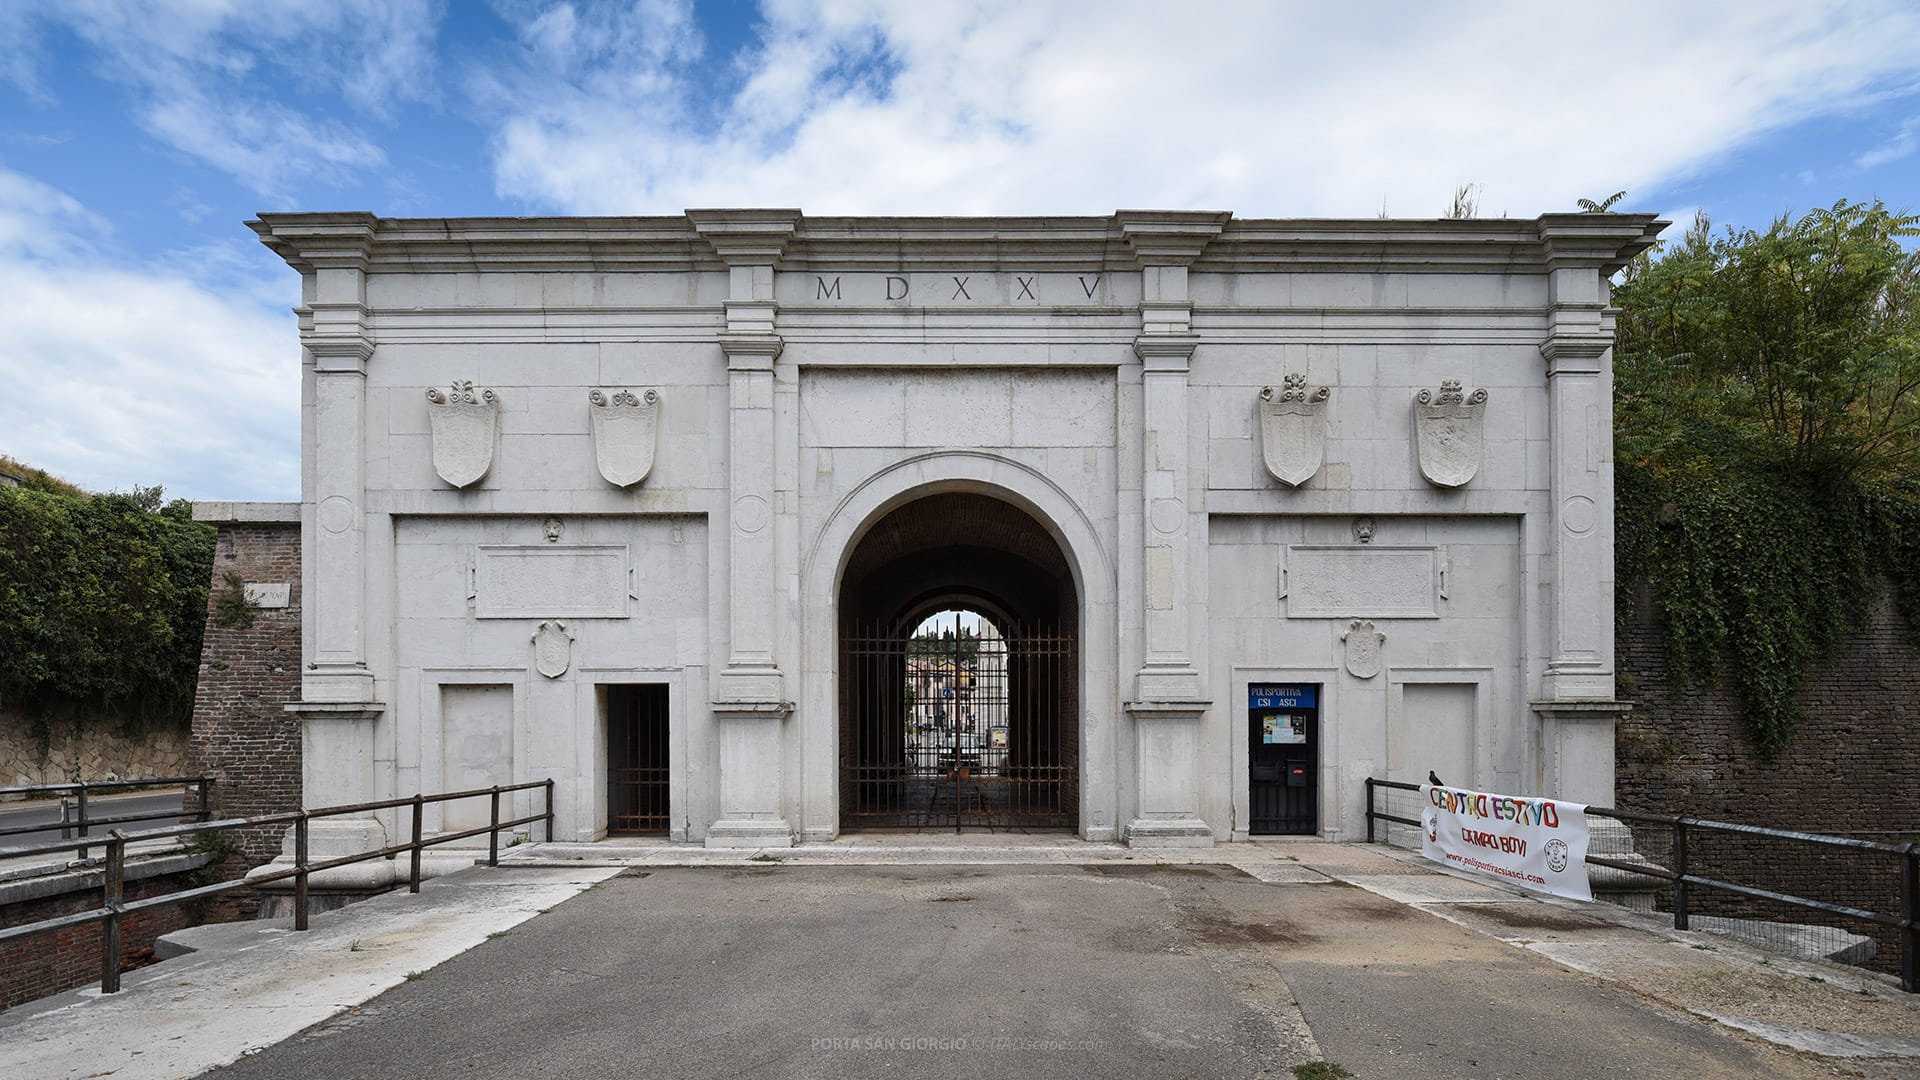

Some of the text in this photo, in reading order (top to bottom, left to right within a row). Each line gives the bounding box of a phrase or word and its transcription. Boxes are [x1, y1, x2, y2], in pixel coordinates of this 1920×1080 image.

[816, 276, 1100, 300] M D X X V
[1251, 688, 1301, 696] POLISPORTIVA
[1257, 698, 1297, 707] CSI ASCI
[1430, 787, 1559, 828] CENTRO ESTIVO
[1461, 827, 1527, 858] CAMPO BOVI
[1445, 853, 1546, 884] www.polisportivacsiasci.com
